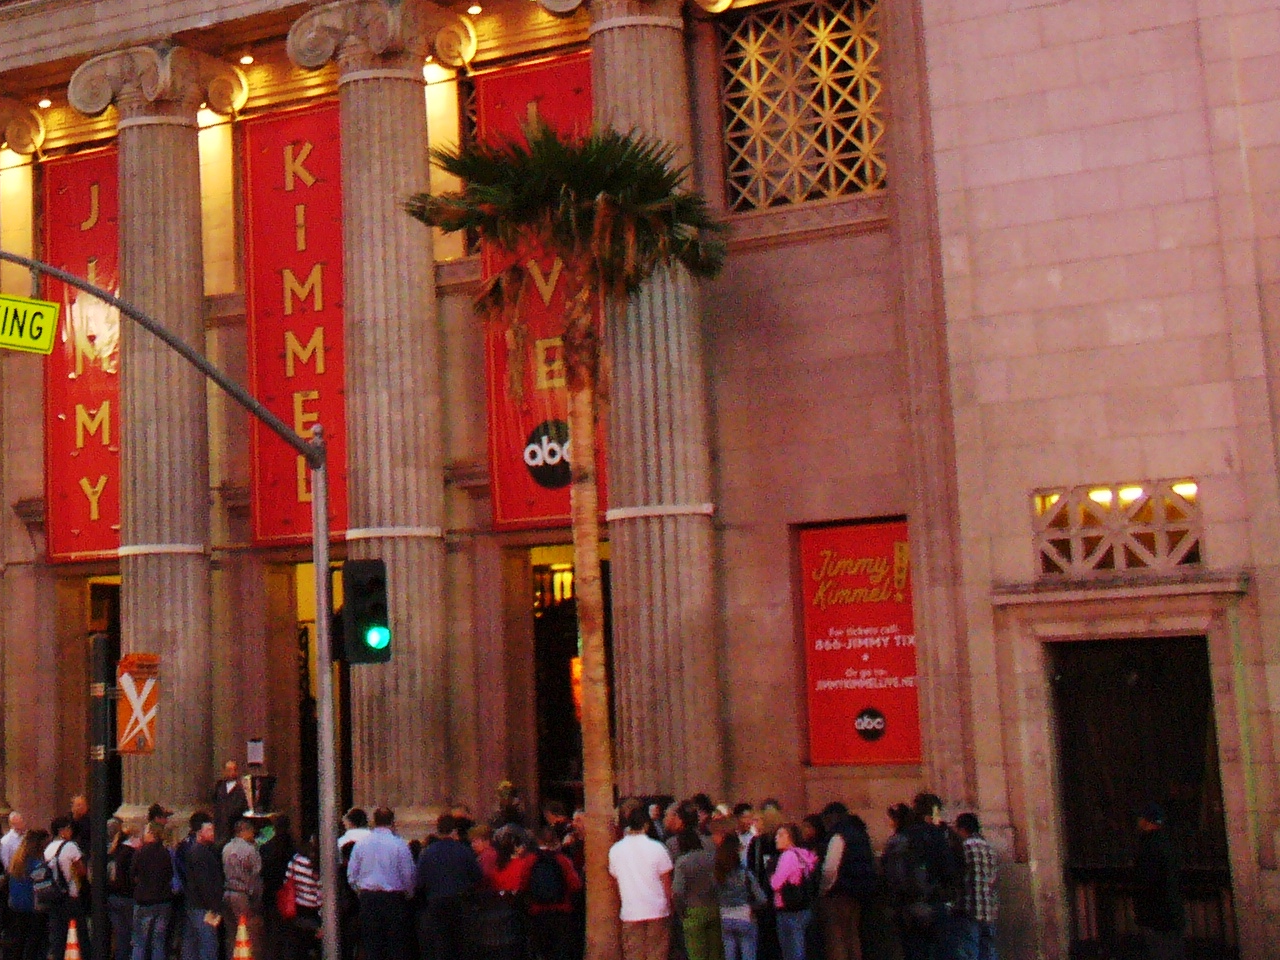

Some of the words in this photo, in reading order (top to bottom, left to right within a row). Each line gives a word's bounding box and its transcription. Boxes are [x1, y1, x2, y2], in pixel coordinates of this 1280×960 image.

[282, 141, 325, 503] KIMMEL
[812, 547, 890, 585] Jimmy
[812, 578, 892, 612] Kimmel
[815, 635, 890, 651] 866-JIMMY
[854, 714, 885, 730] abc
